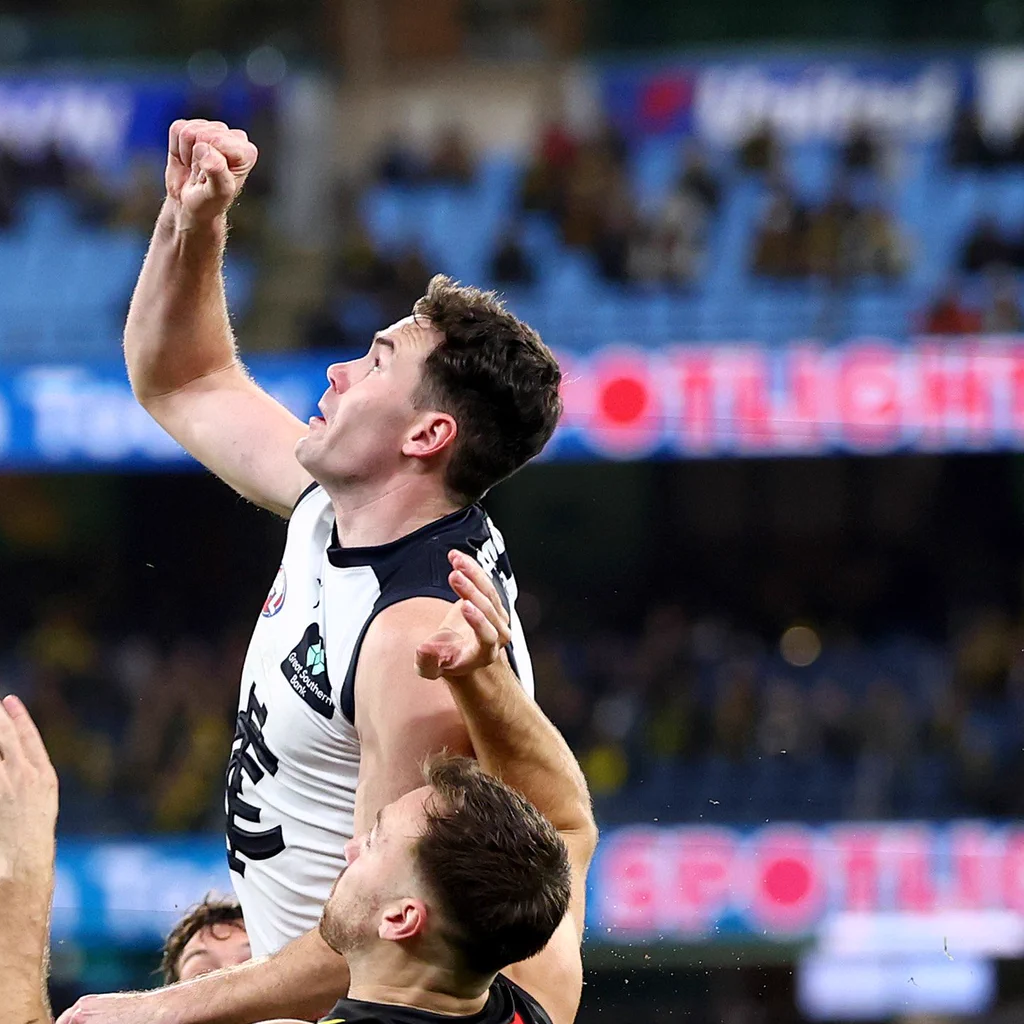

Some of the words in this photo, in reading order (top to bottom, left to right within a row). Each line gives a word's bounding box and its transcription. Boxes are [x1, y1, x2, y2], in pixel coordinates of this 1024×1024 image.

[288, 652, 304, 674] Great
[299, 669, 333, 706] Southern
[289, 673, 307, 698] Bank
